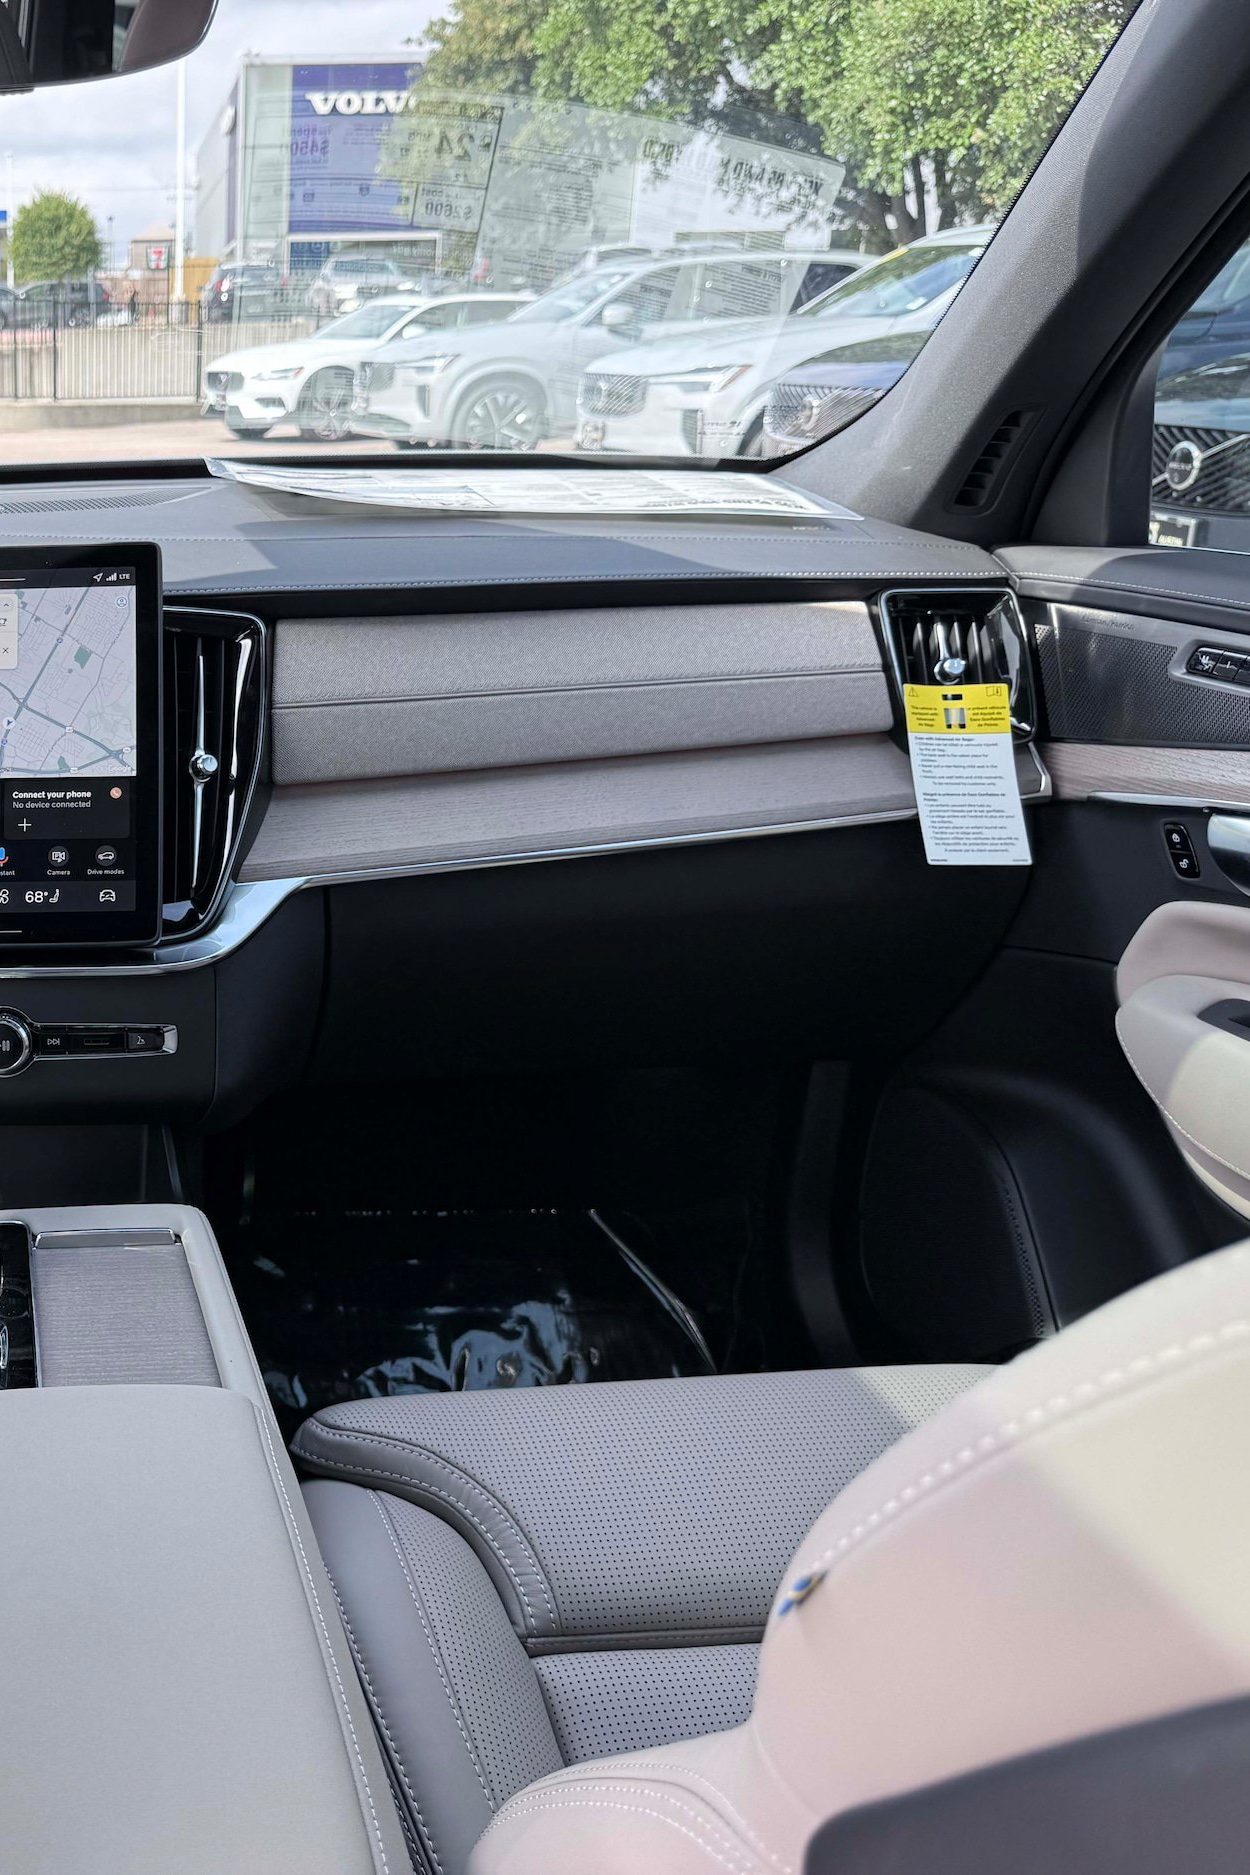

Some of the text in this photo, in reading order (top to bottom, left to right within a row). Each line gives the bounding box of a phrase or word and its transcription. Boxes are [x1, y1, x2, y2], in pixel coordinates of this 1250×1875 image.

[306, 91, 416, 115] VOLV
[119, 572, 131, 580] LTE
[12, 790, 91, 800] Connect your phone
[13, 800, 91, 809] No device connected
[25, 891, 48, 903] 68°
